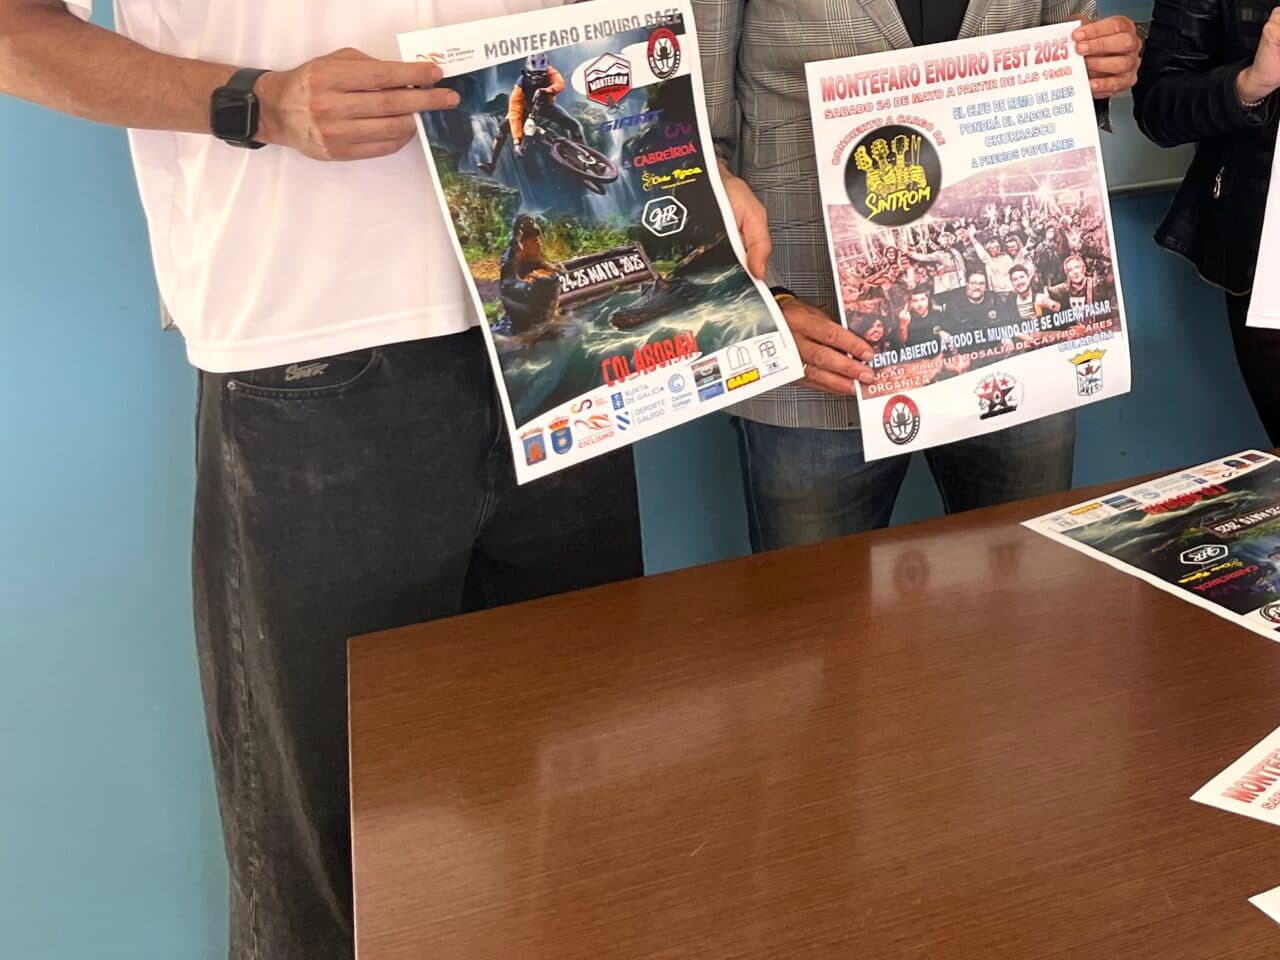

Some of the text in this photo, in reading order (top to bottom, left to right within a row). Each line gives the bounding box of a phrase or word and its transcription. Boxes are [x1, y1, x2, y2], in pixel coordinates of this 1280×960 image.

[483, 26, 580, 60] MONTEFARO
[584, 15, 640, 41] ENDURO
[820, 37, 1069, 102] MONTEFARO ENDURO FEST 2025
[824, 102, 874, 119] SABADO
[894, 95, 909, 107] DE
[912, 89, 944, 104] MAYO
[946, 86, 955, 97] A
[957, 80, 998, 96] PARTIR
[1000, 75, 1015, 87] DE
[1018, 72, 1040, 85] LAS
[953, 85, 1075, 120] EL CLUB DE REMO DE ARES
[960, 102, 1074, 135] PONDRÁ EL SABOR CON
[985, 123, 1056, 148] CHURRASCO
[832, 118, 883, 165] CONCIERTO
[885, 115, 895, 125] A
[896, 114, 934, 131] CARGO
[971, 158, 979, 168] A
[1021, 138, 1075, 157] POPULARES
[559, 269, 589, 293] 24-25
[620, 255, 646, 275] 2025
[868, 350, 898, 368] VENTO
[900, 340, 939, 362] ABIERTO
[949, 331, 973, 348] TODO
[974, 329, 986, 343] EL
[987, 323, 1020, 341] MUNDO
[1021, 319, 1040, 333] QUE
[1041, 315, 1052, 330] SE
[1053, 308, 1084, 326] QUIERA
[1085, 300, 1111, 318] PASAR
[1033, 329, 1076, 345] CASTRO
[1086, 319, 1113, 331] ARES
[1058, 330, 1114, 352] COLABORA
[602, 330, 700, 387] COLABORAN
[868, 375, 931, 394] ORGANIZA
[578, 430, 615, 449] CICLISMO
